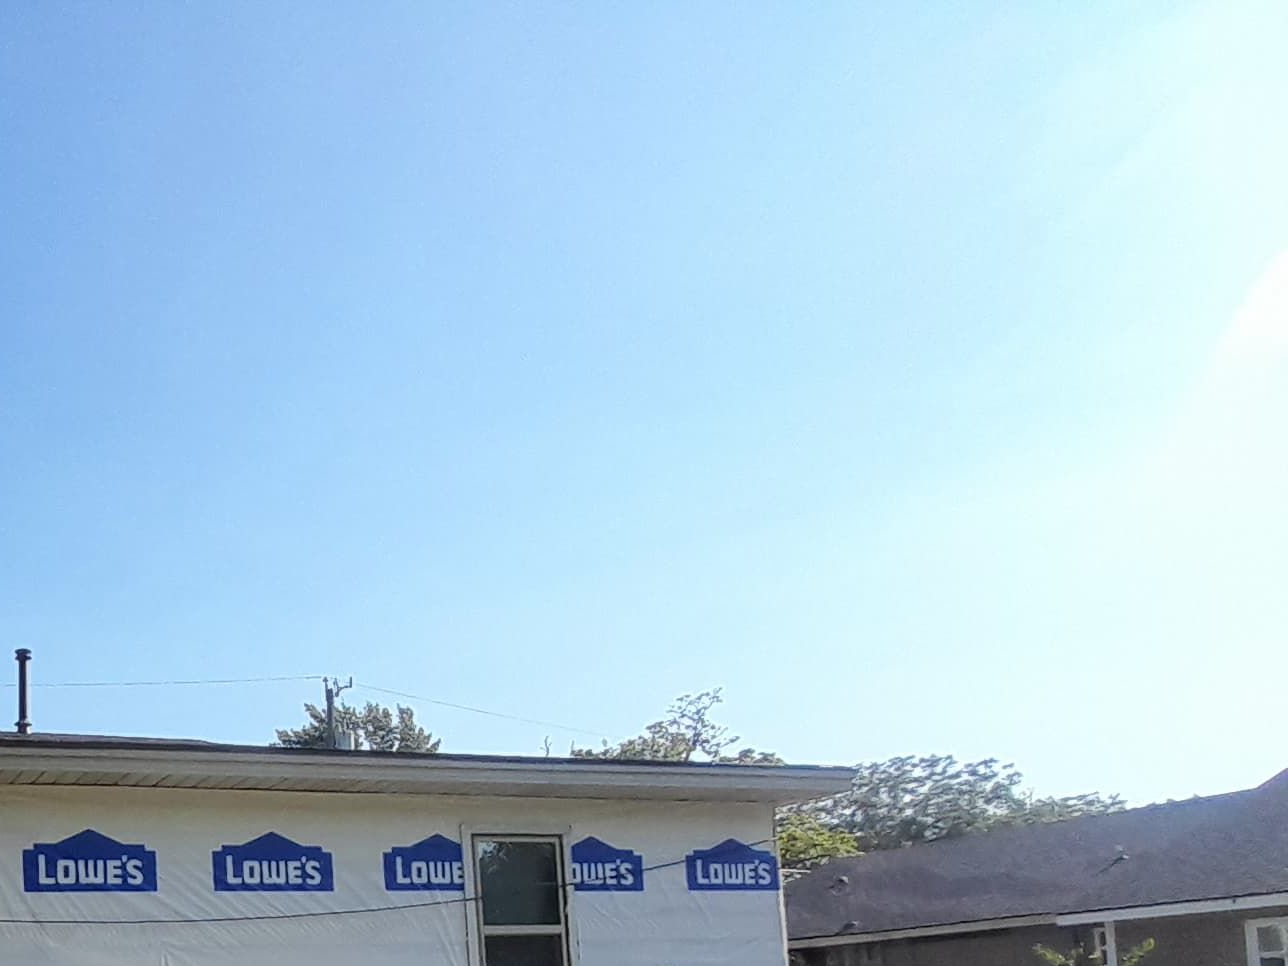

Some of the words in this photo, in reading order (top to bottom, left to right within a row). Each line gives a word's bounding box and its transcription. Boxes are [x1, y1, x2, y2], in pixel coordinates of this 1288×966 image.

[37, 854, 144, 885] LOWE'S
[225, 855, 322, 886] LOWE'S
[696, 859, 771, 886] LOWE'S
